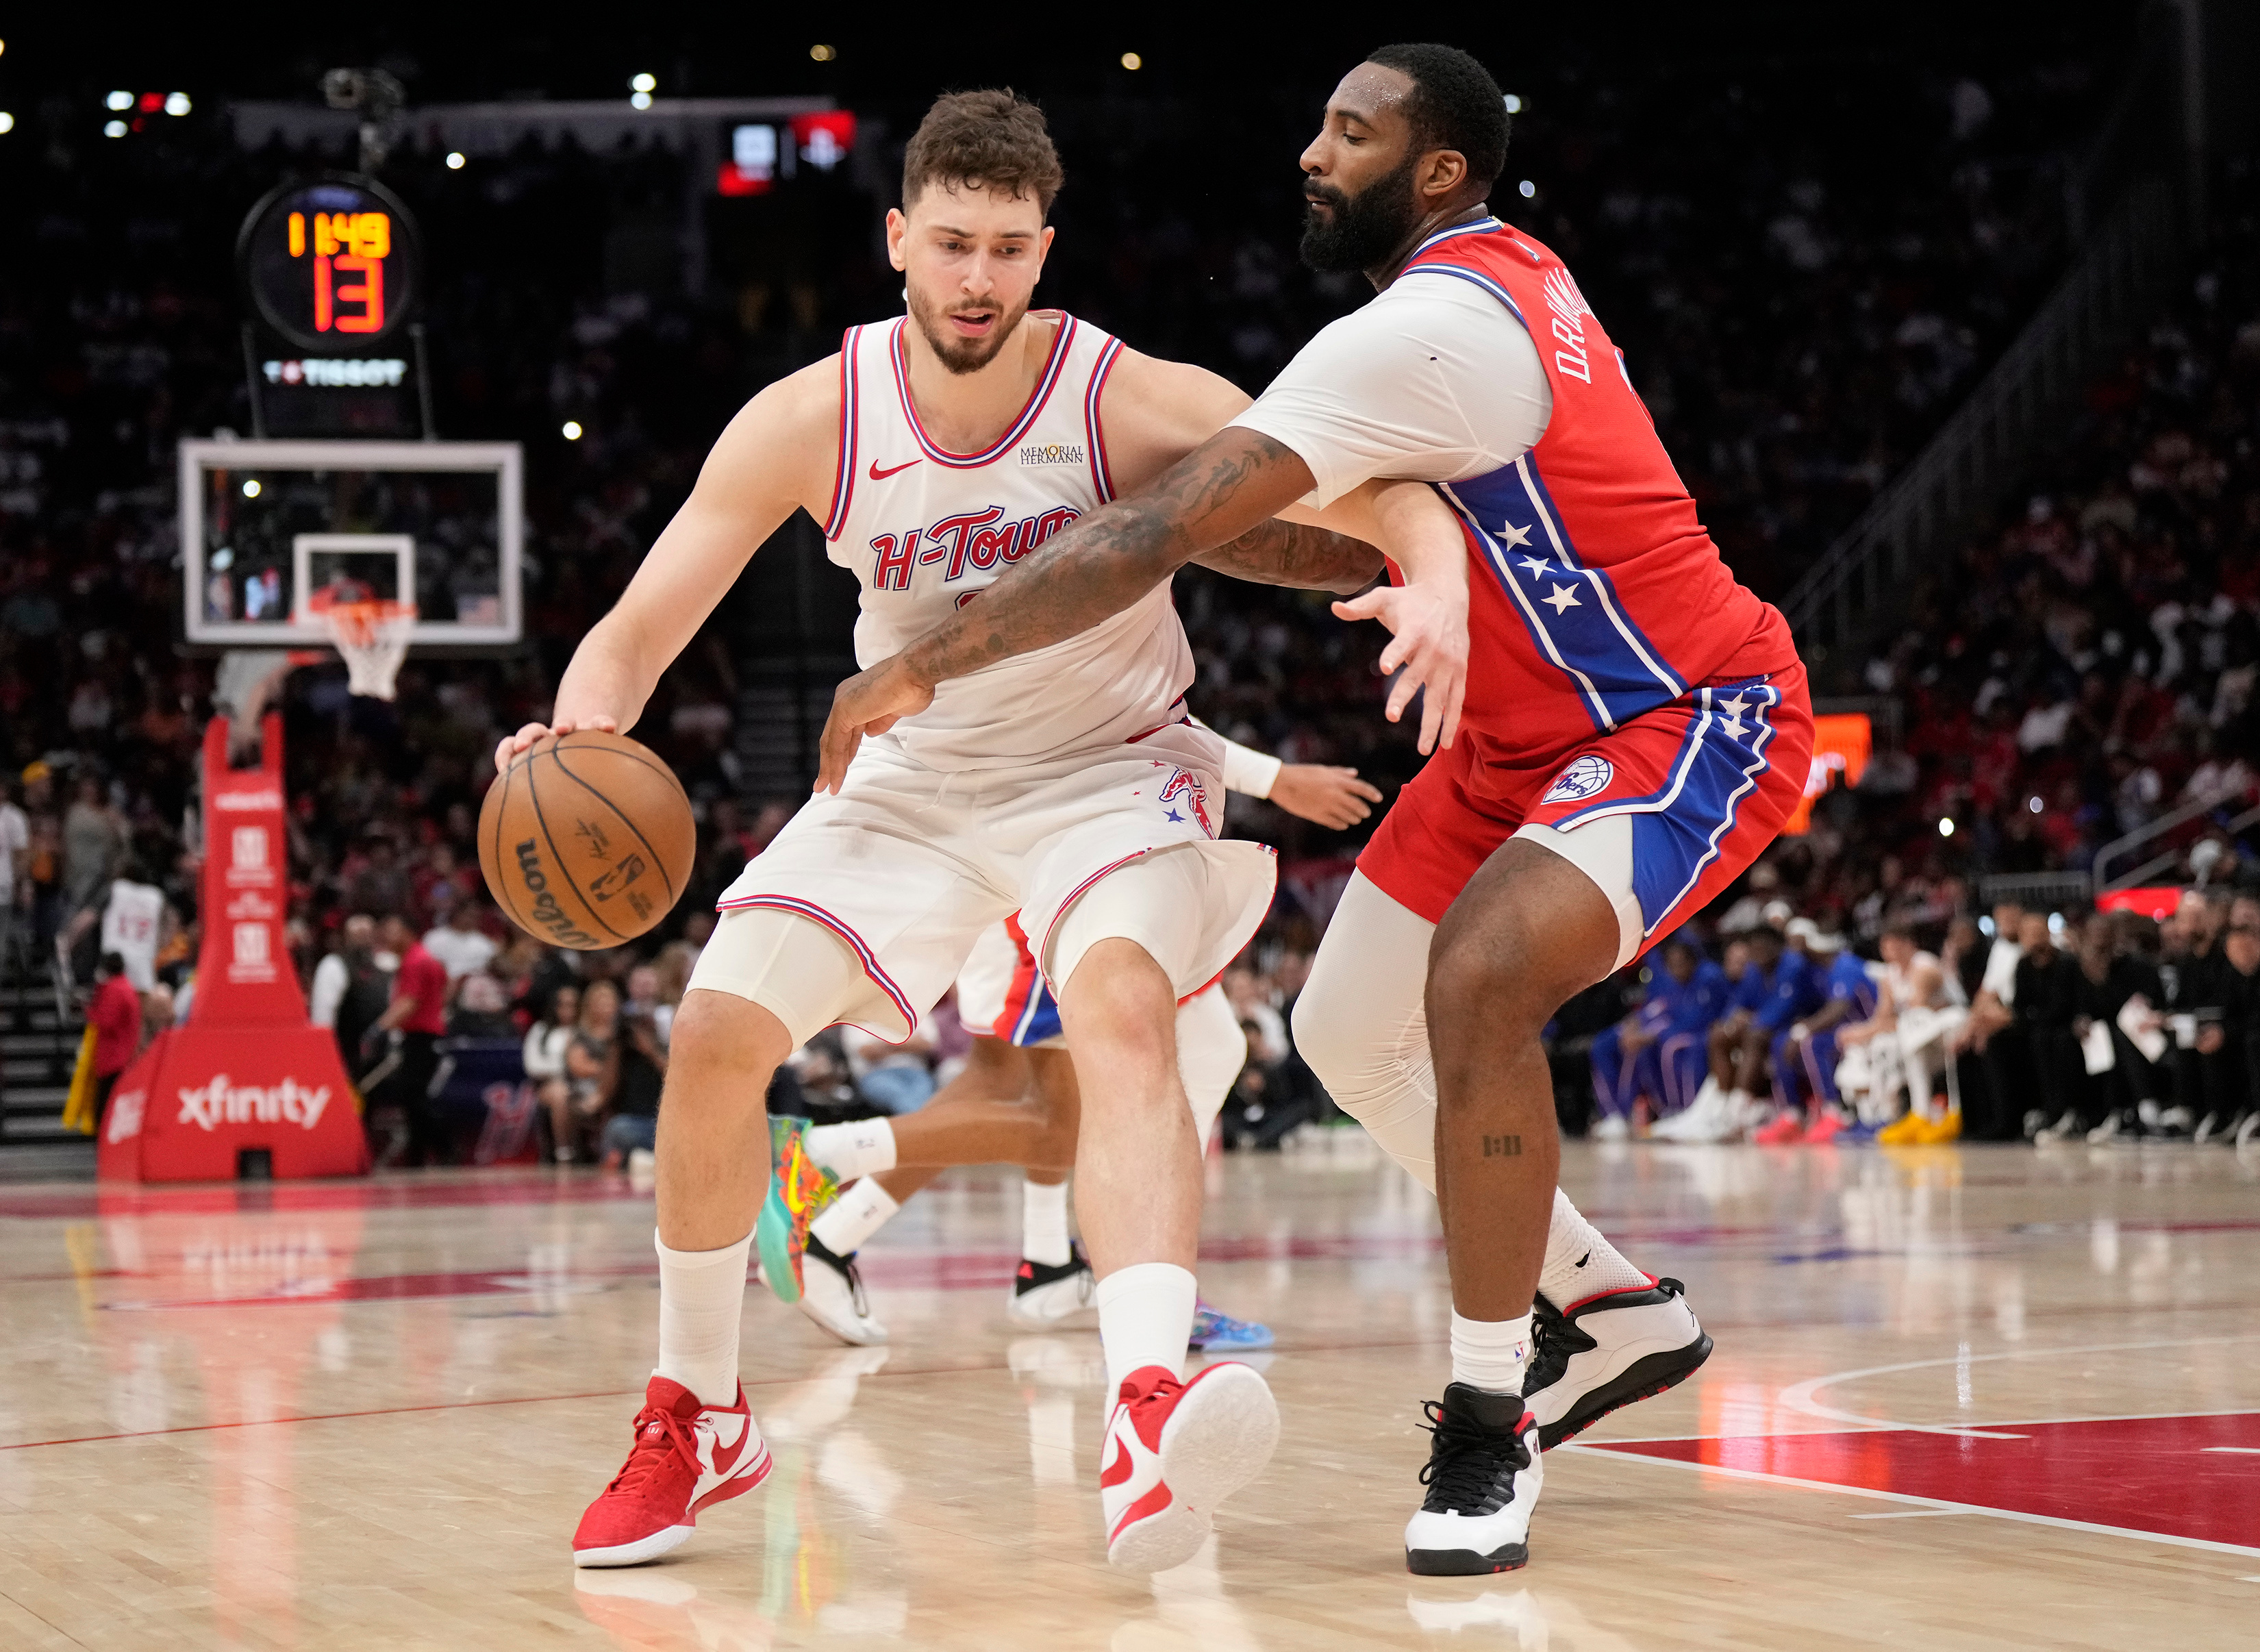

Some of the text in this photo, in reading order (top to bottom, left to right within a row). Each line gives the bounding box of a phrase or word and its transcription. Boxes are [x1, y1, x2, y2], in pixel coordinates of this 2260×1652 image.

[288, 212, 390, 258] 11:49
[314, 254, 384, 333] 13
[1544, 267, 1600, 384] DRUMMO
[1020, 445, 1083, 457] MEMORIAL
[1020, 454, 1083, 464] HERMANN
[516, 837, 601, 947] Wilson
[177, 1072, 332, 1132] xfinity
